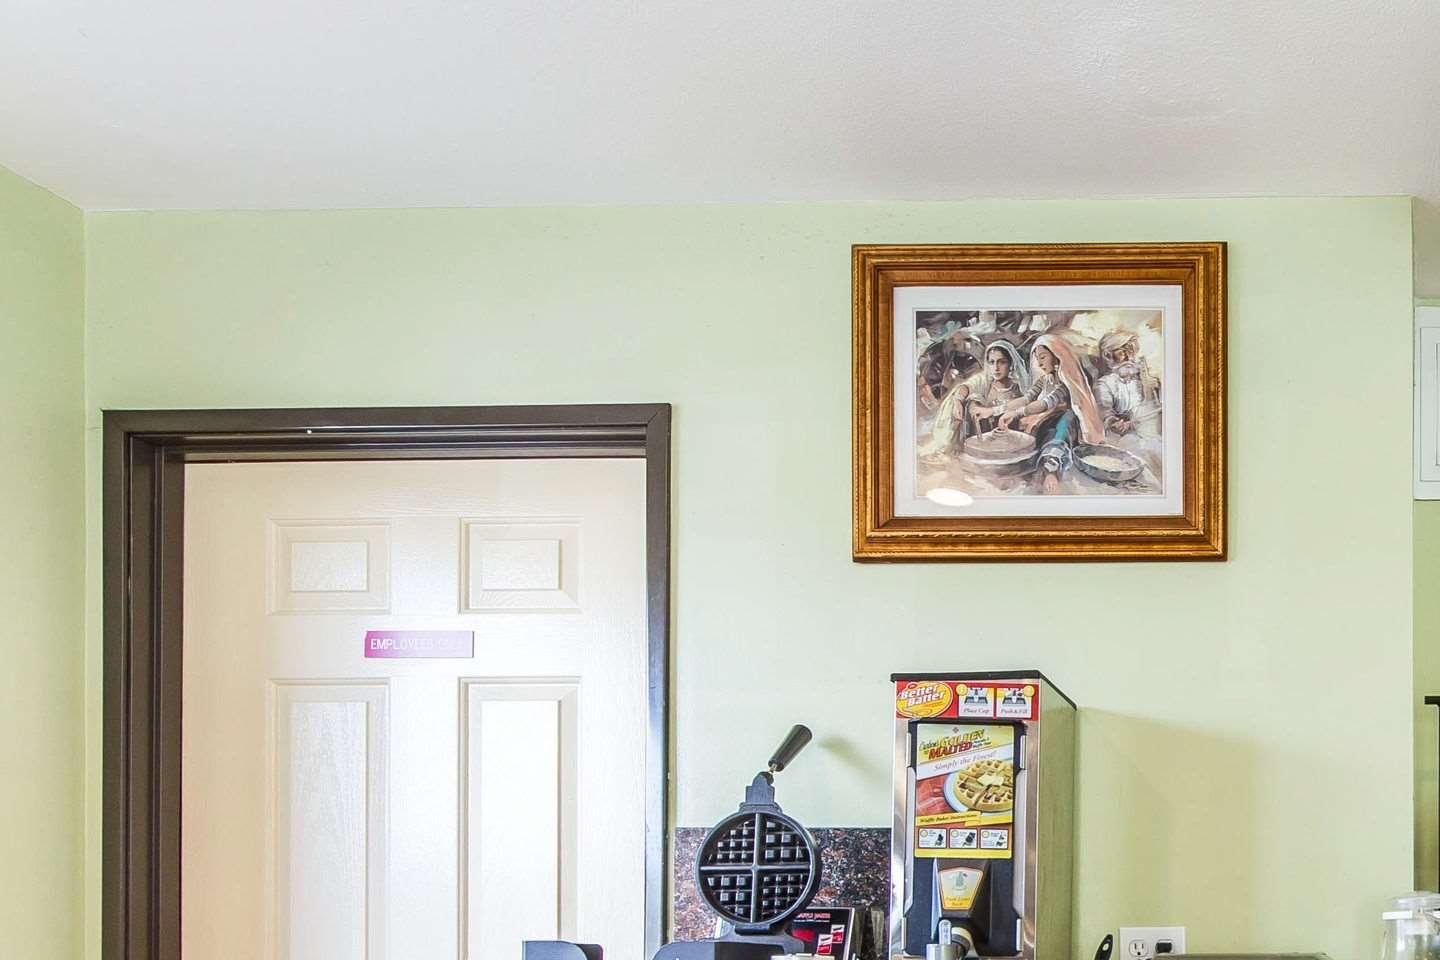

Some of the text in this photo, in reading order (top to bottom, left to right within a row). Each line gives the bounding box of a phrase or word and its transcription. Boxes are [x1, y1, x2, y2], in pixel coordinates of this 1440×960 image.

[900, 683, 938, 699] Better
[906, 691, 944, 708] Batter
[928, 741, 972, 760] MALTED
